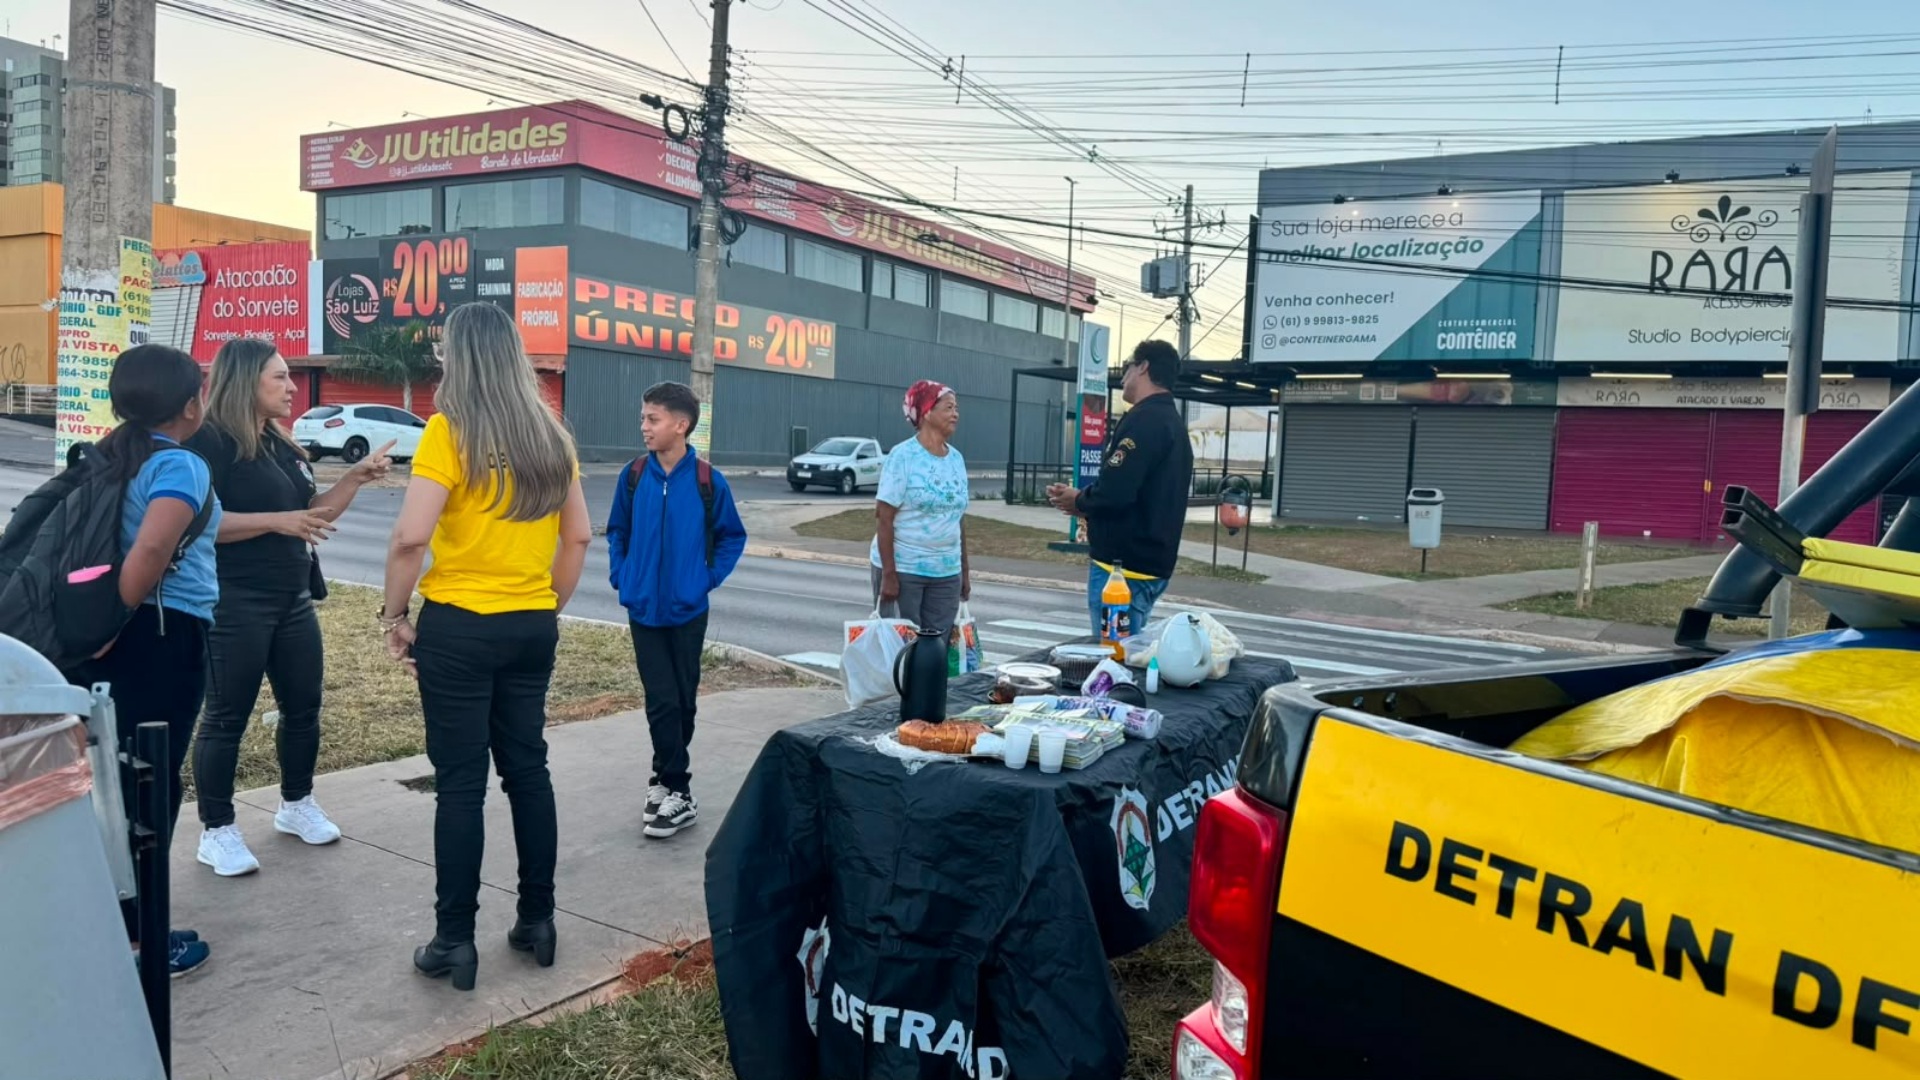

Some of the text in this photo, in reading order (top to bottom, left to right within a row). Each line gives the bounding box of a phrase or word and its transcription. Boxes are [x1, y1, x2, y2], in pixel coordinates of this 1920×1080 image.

[379, 117, 568, 165] JJUtilidades
[665, 152, 697, 174] DECORA
[1271, 211, 1463, 239] Sua loja merece a
[1267, 236, 1484, 263] melhor localização
[152, 262, 200, 279] elattos
[485, 257, 504, 272] MODA
[214, 264, 297, 289] Atacadão
[337, 284, 364, 299] Lojas
[383, 277, 398, 298] R$
[478, 282, 512, 296] FEMININA
[517, 280, 563, 303] FABRICAÇÃO
[212, 294, 299, 318] do Sorvete
[325, 298, 380, 315] São Luiz
[1265, 291, 1395, 308] Venha conhecer!
[97, 303, 123, 318] GDF
[521, 309, 559, 327] PRÓPRIA
[1280, 314, 1379, 328] (61) 9 99813-9825
[1438, 318, 1517, 328] CENTRO COMERCIAL
[284, 326, 306, 342] Açaí
[1279, 333, 1377, 346] @CONTEINERGAMA
[1437, 328, 1517, 350] CONTÊINER
[1628, 328, 1682, 345] Studio
[72, 340, 120, 354] VISTA
[1676, 395, 1766, 406] ATACADO E VAREJO
[1080, 448, 1102, 464] PASSE
[1385, 820, 1920, 1051] DETRAN DF
